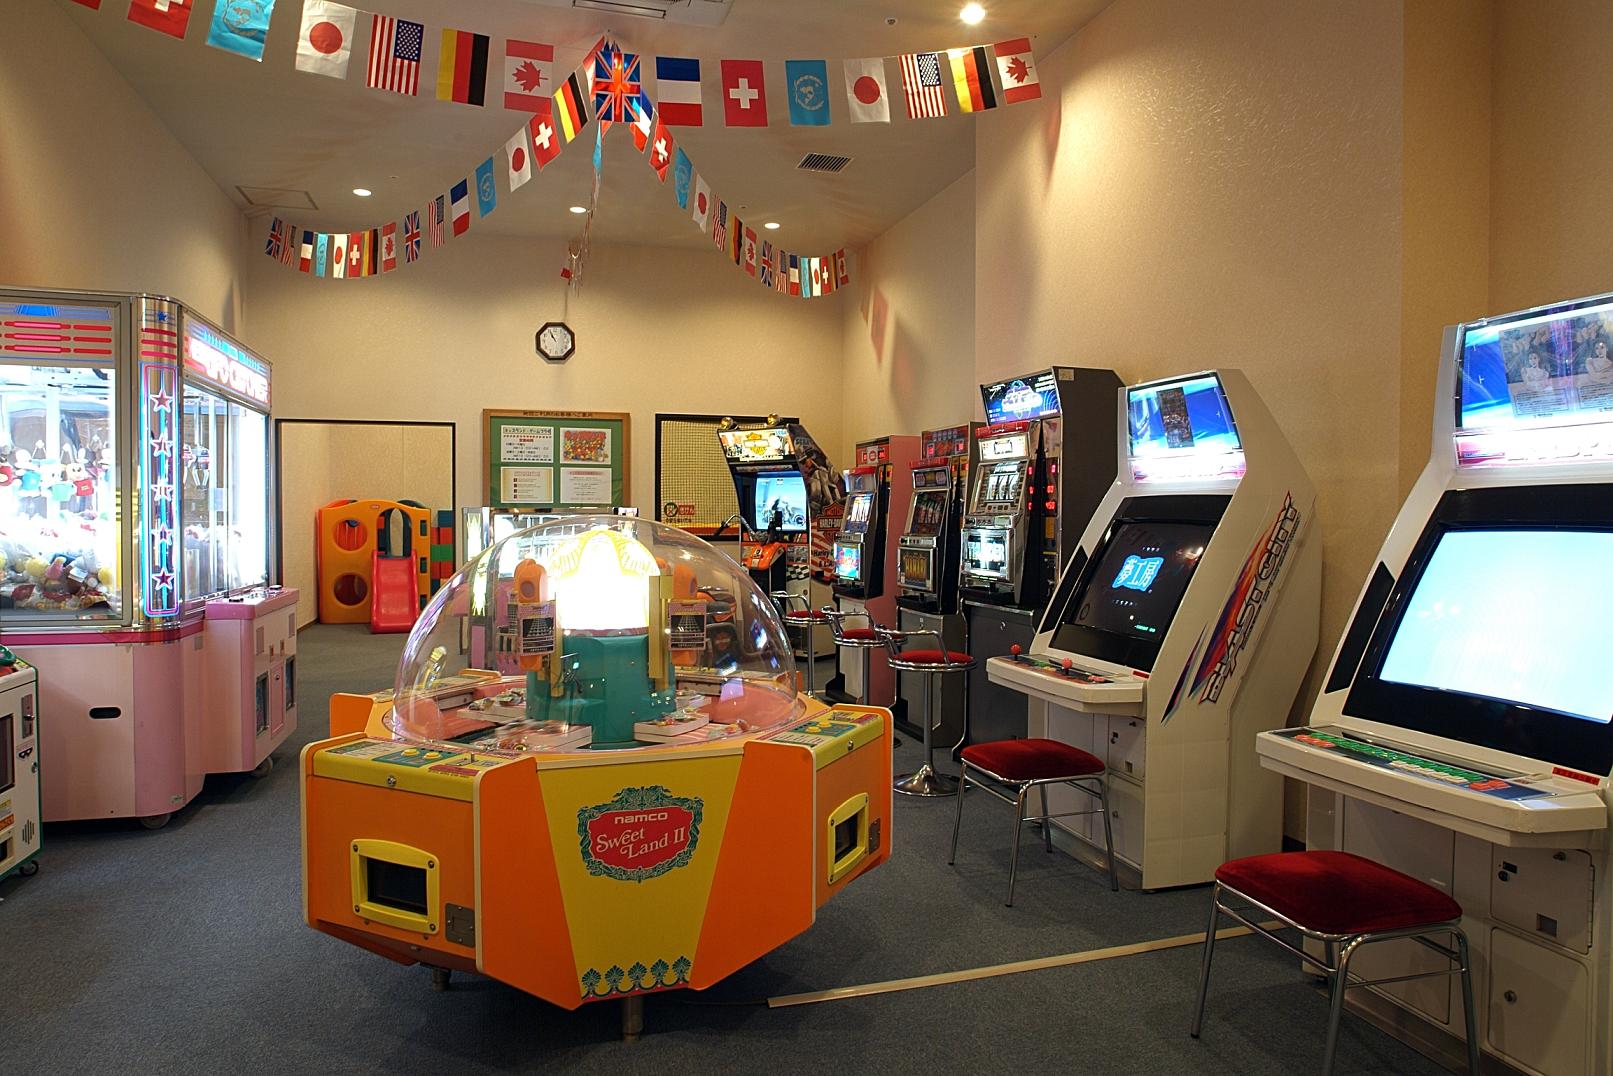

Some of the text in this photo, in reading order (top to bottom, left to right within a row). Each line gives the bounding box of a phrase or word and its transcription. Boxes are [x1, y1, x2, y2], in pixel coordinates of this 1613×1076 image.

[1198, 575, 1263, 704] BLAST
[1257, 490, 1297, 580] CITY
[614, 811, 668, 824] namco
[596, 826, 645, 853] Sweet
[620, 826, 686, 859] Land II
